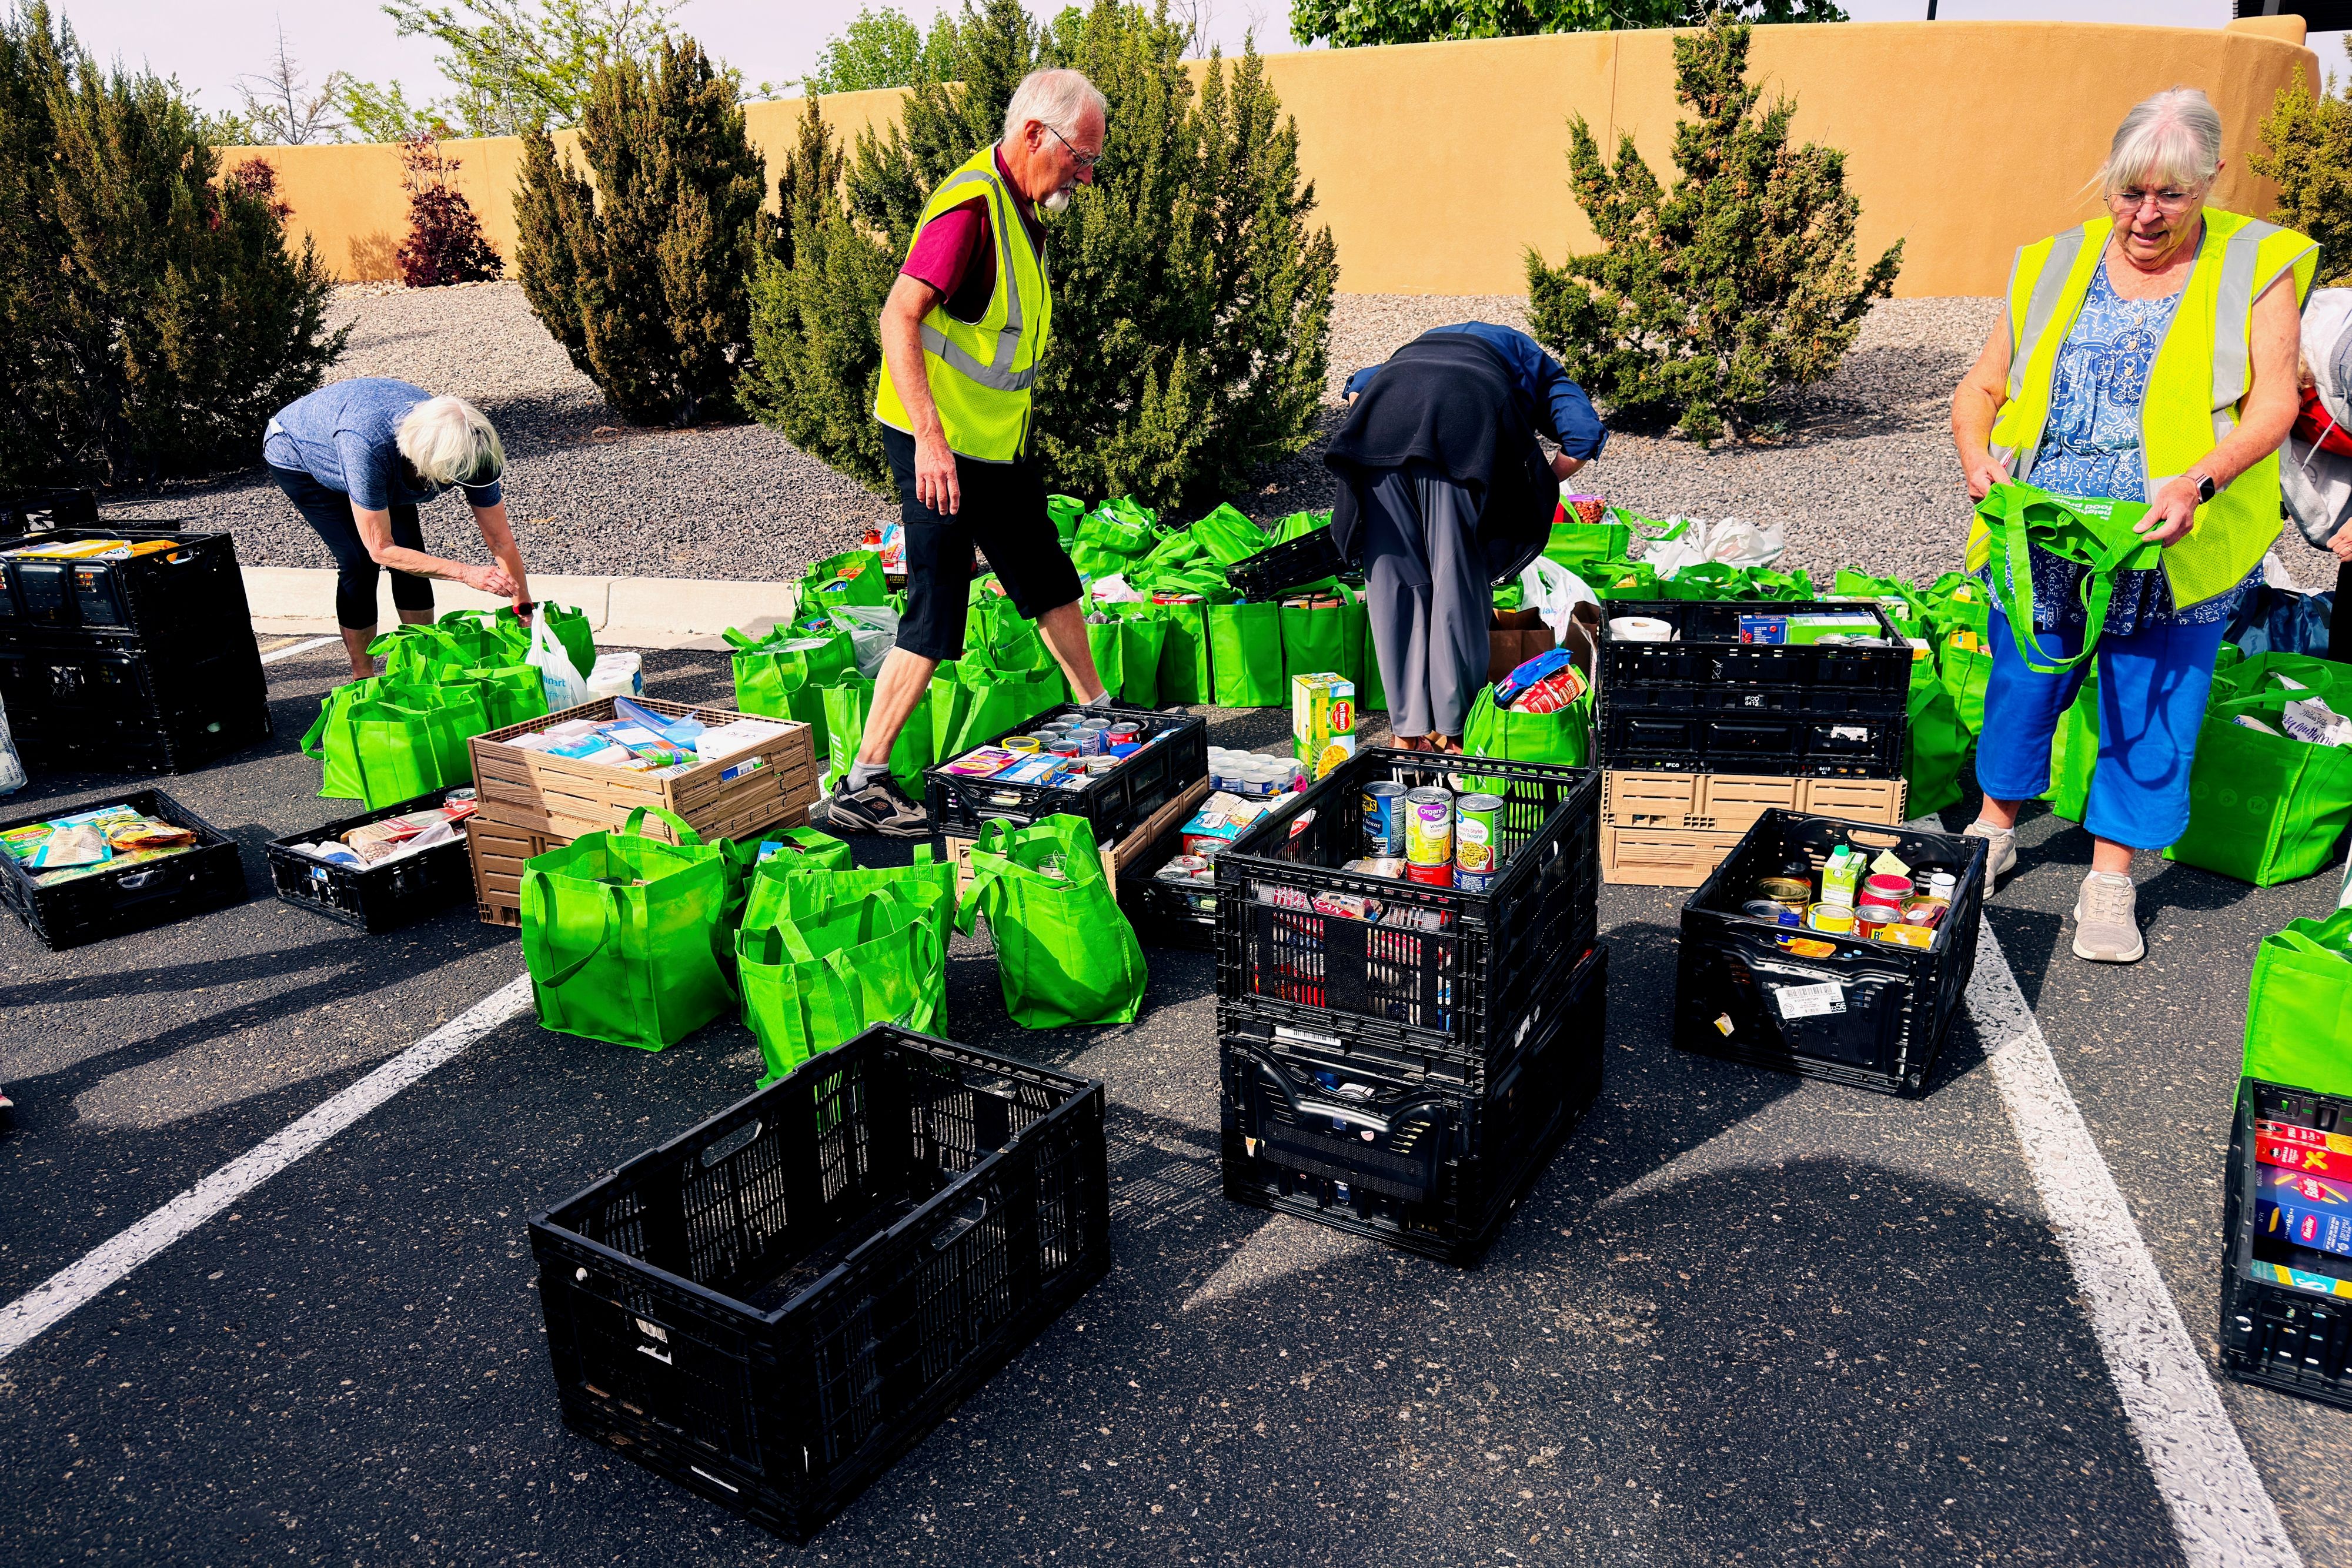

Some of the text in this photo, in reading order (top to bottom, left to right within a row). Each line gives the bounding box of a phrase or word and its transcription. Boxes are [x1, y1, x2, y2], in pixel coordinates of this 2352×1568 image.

[1421, 807, 1445, 816] Organic
[1365, 818, 1381, 828] Beans
[2303, 1178, 2319, 1198] Barilla
[2303, 1217, 2314, 1239] Barilla
